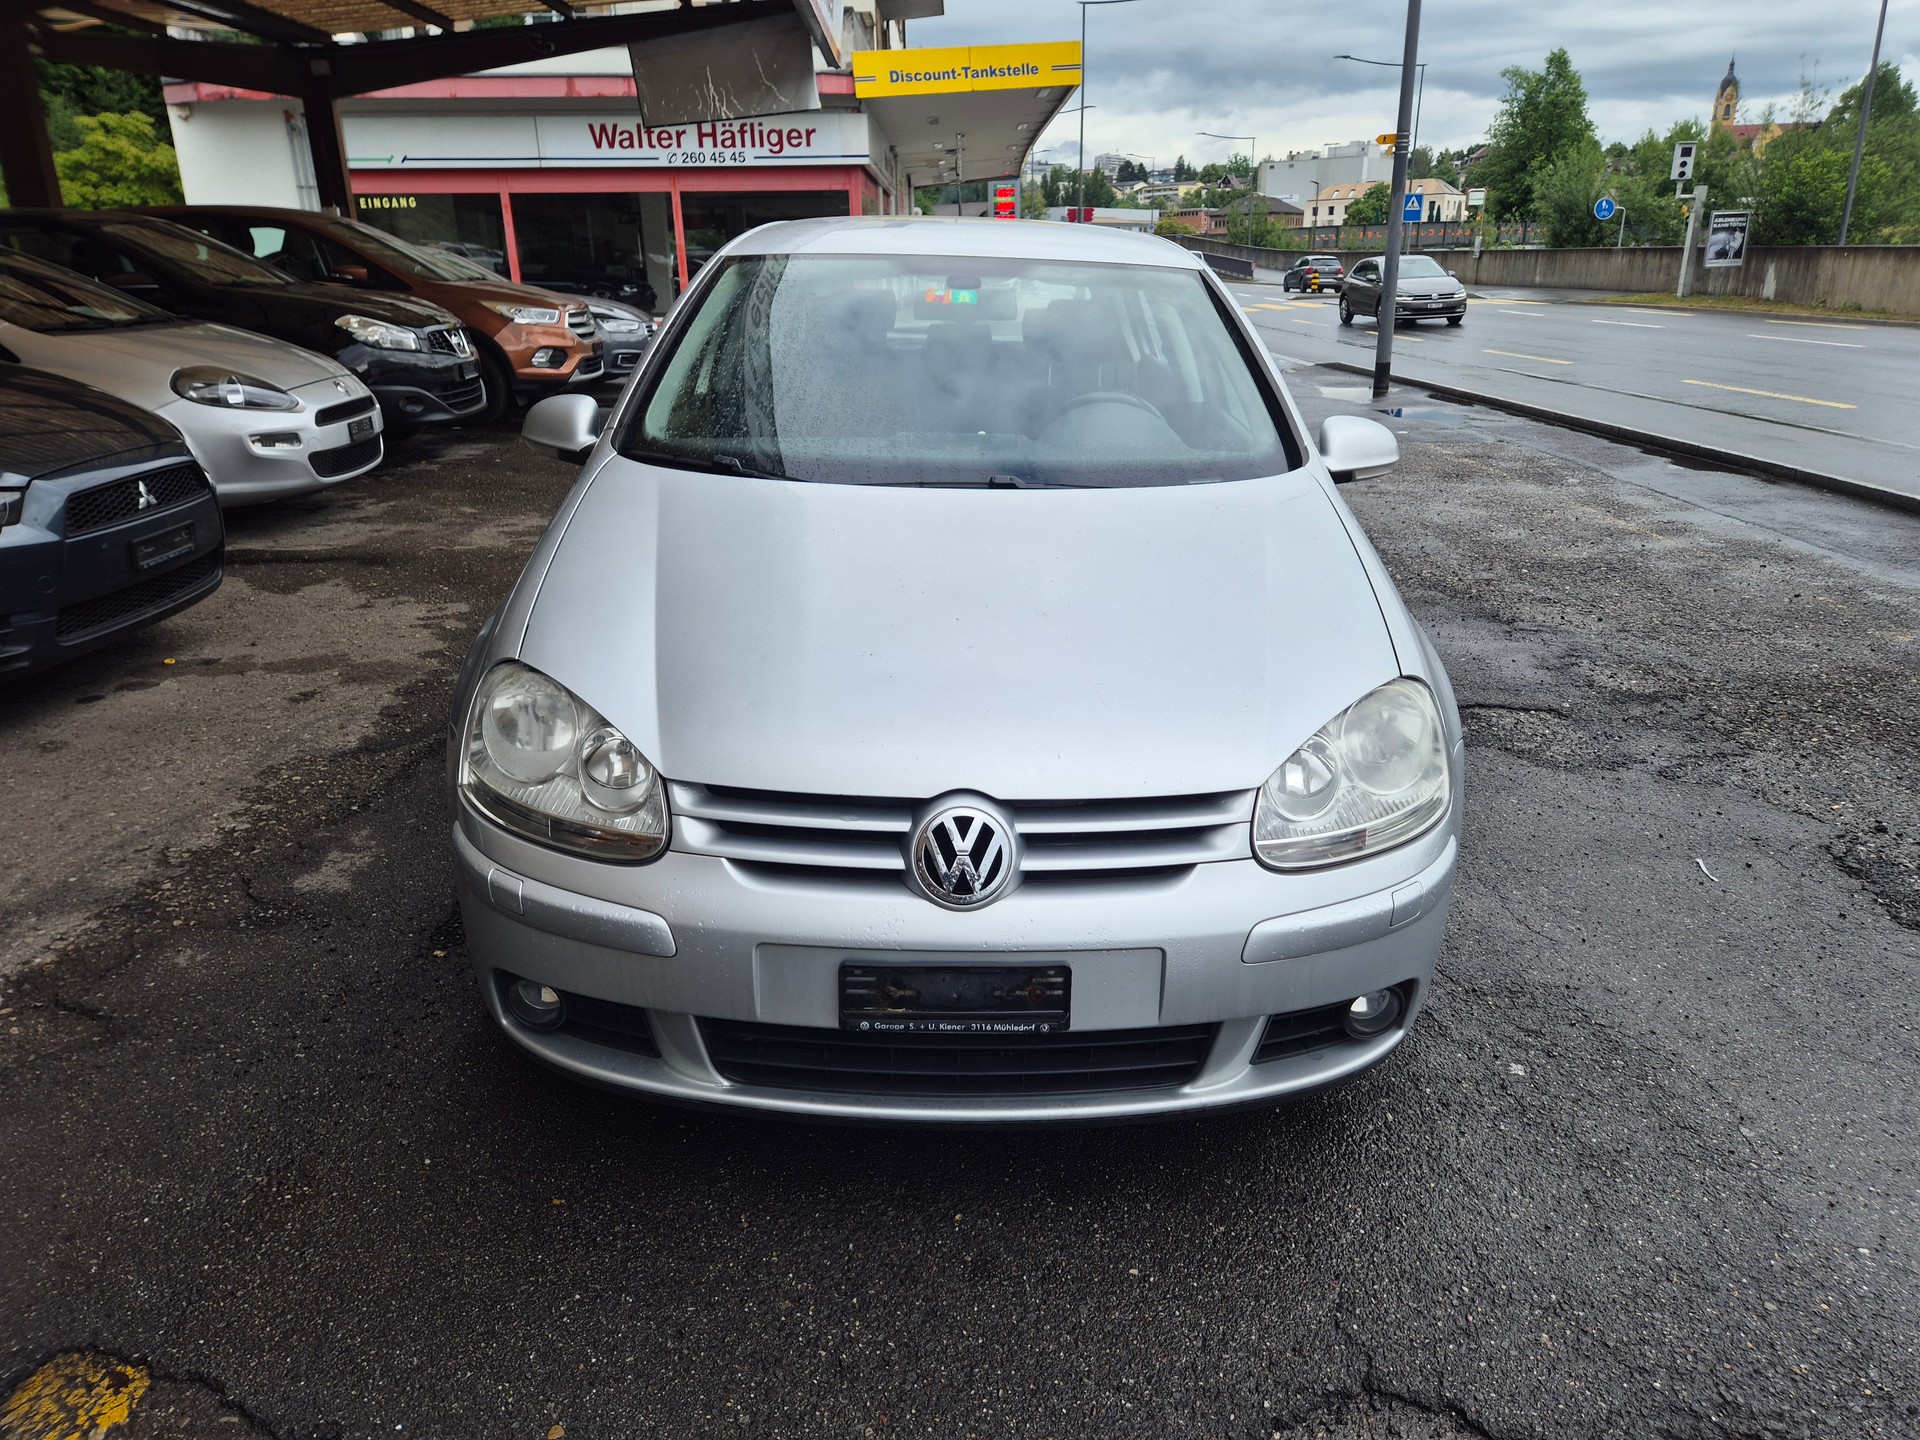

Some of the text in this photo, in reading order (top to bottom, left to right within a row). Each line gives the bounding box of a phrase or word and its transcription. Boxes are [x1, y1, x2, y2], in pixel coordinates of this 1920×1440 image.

[889, 63, 1039, 83] Discount-Tankstelle
[588, 121, 817, 154] Walter Häfliger
[681, 151, 746, 164] 260 45 45
[359, 196, 417, 209] EINGANG
[874, 1022, 905, 1031] Garage
[909, 1022, 917, 1030] S.
[939, 1023, 966, 1031] Kiener
[971, 1023, 992, 1031] 3116
[993, 1023, 1036, 1032] Mühledorf
